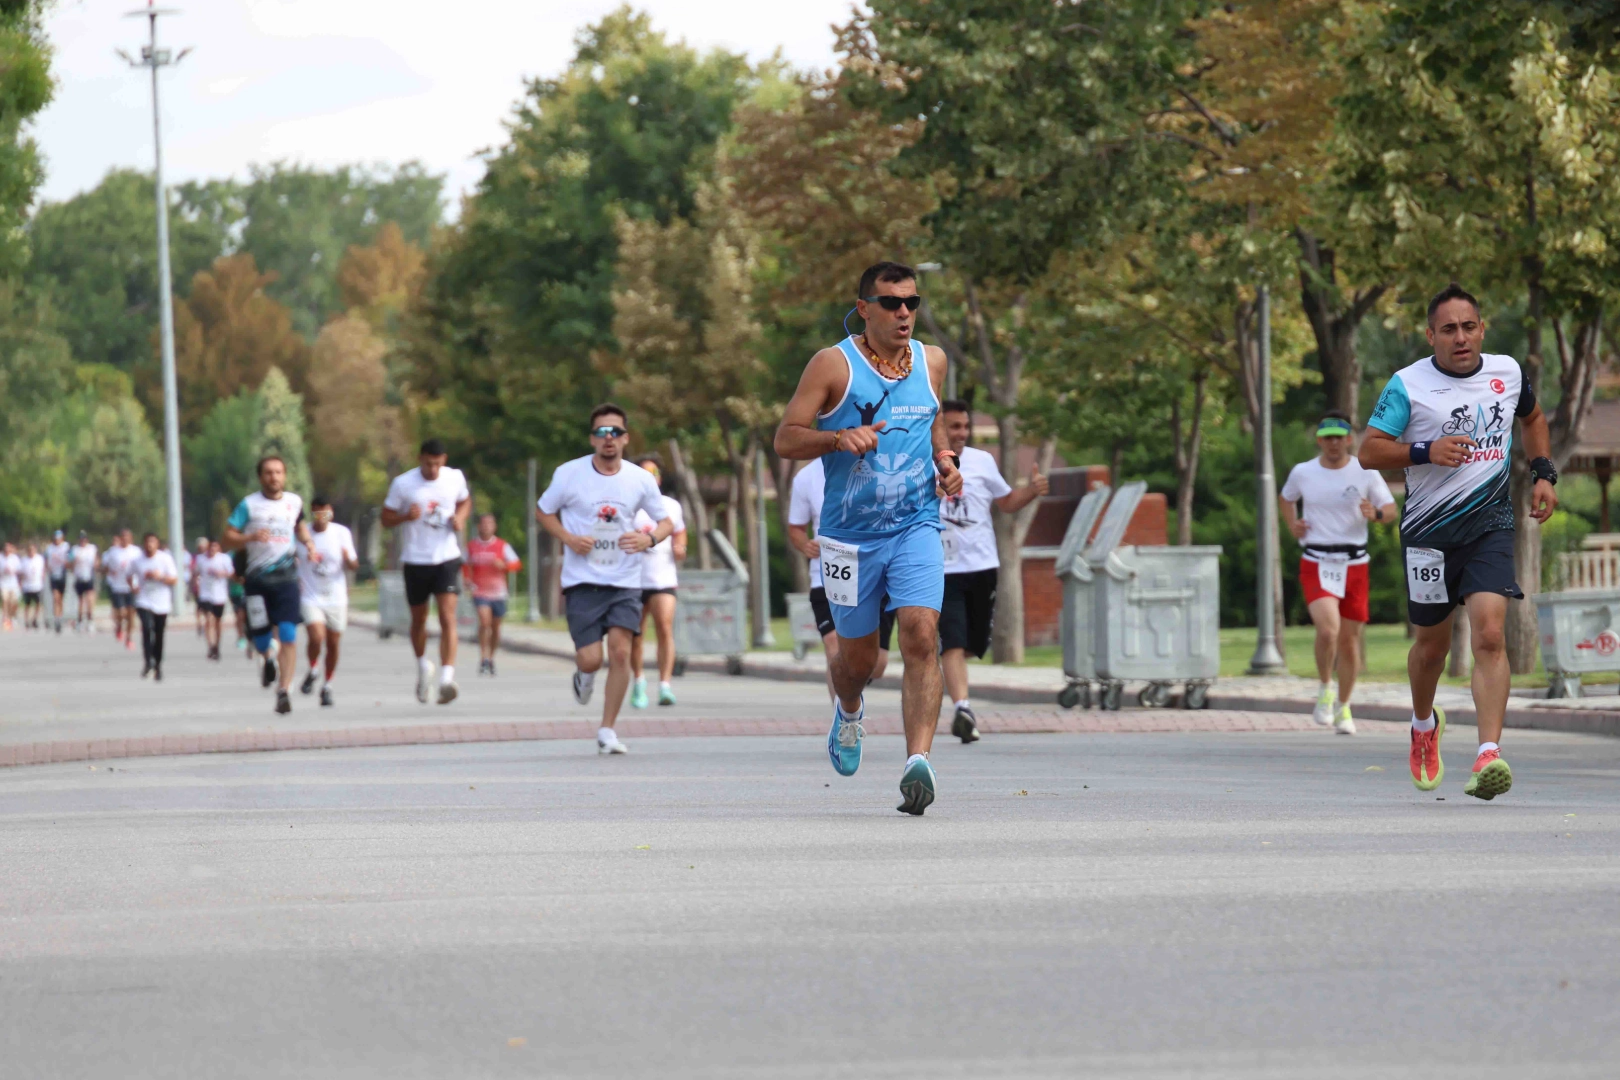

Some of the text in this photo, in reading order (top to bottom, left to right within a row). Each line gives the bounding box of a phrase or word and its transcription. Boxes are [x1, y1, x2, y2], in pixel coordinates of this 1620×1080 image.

[891, 405, 910, 414] KONYA
[824, 561, 851, 581] 326
[1412, 566, 1441, 582] 189
